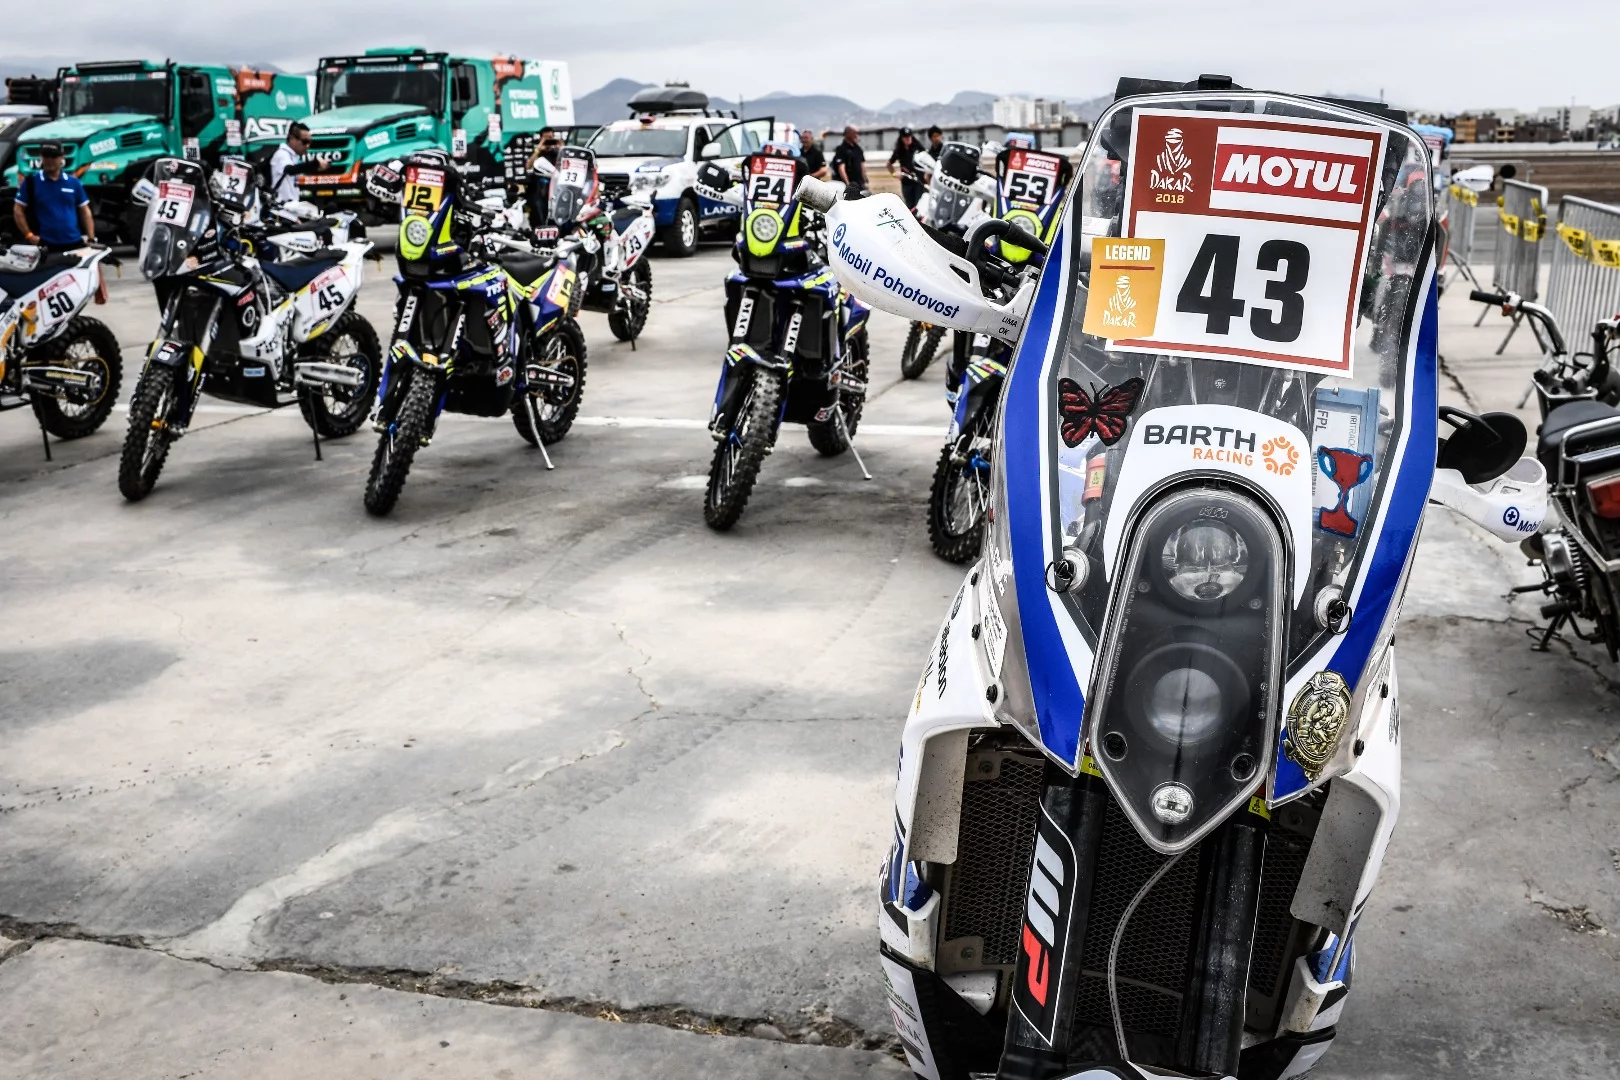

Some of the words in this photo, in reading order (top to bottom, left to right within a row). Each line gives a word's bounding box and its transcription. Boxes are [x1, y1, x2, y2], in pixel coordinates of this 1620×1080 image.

[564, 172, 578, 183] 33
[1149, 168, 1194, 193] DAKAR
[1220, 153, 1358, 194] MOTUL
[407, 185, 434, 211] 12
[752, 176, 787, 202] 24
[1009, 171, 1049, 205] 53
[1155, 193, 1185, 204] 2018
[157, 201, 180, 220] 45
[704, 205, 736, 216] LAND
[1105, 244, 1151, 261] LEGEND
[838, 243, 872, 275] Mobil
[872, 266, 961, 319] Pohotovost
[1175, 233, 1311, 343] 43
[47, 291, 75, 318] 50
[319, 285, 345, 312] 45
[998, 326, 1009, 336] OK
[1001, 315, 1018, 328] LIMA
[1102, 310, 1137, 329] DAKAR
[1315, 409, 1329, 432] FPL
[1143, 424, 1256, 453] BARTH
[1192, 447, 1254, 466] RACING
